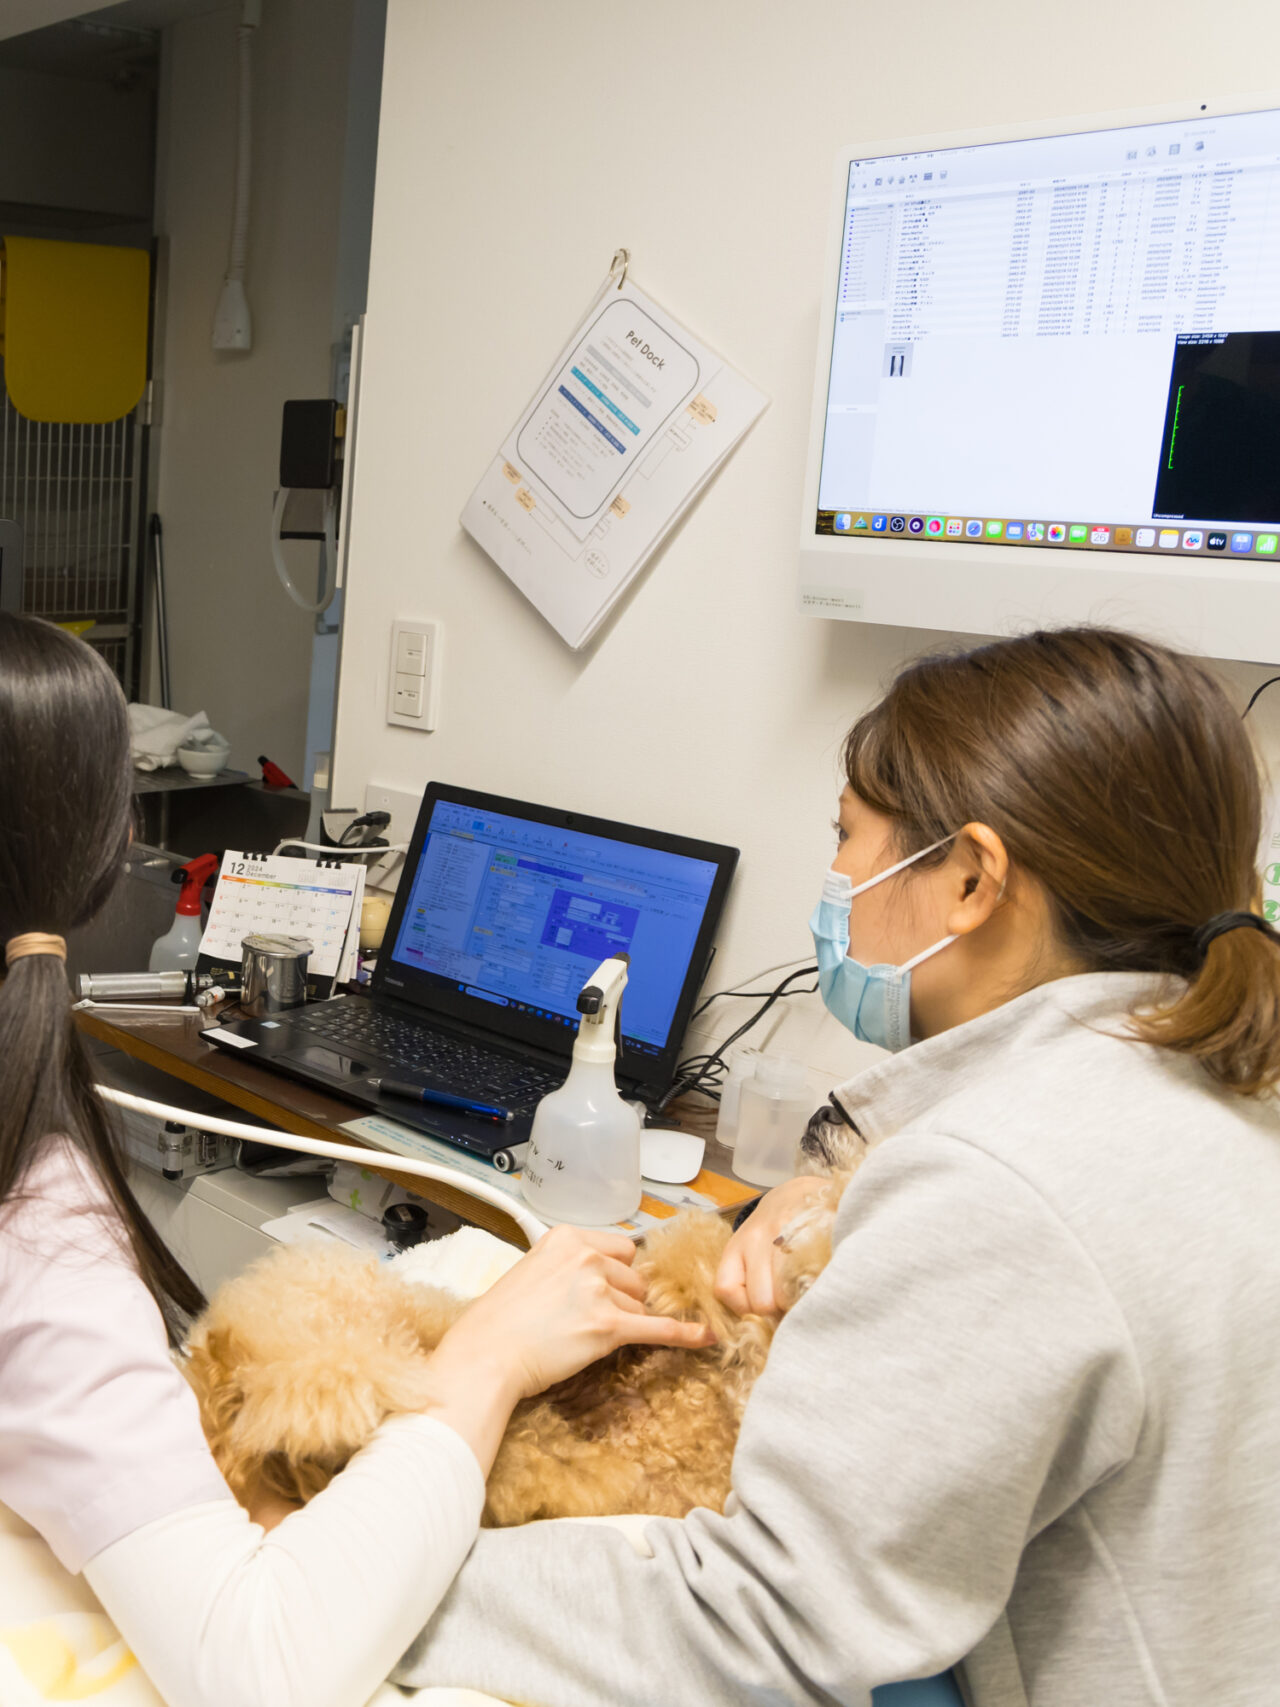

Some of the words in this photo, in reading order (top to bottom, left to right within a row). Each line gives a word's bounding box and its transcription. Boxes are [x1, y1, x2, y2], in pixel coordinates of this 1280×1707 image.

[625, 330, 643, 348] Pet
[640, 344, 665, 371] Dock
[1094, 533, 1106, 542] 26
[230, 862, 245, 875] 12
[246, 870, 276, 879] December
[1265, 902, 1278, 920] 2
